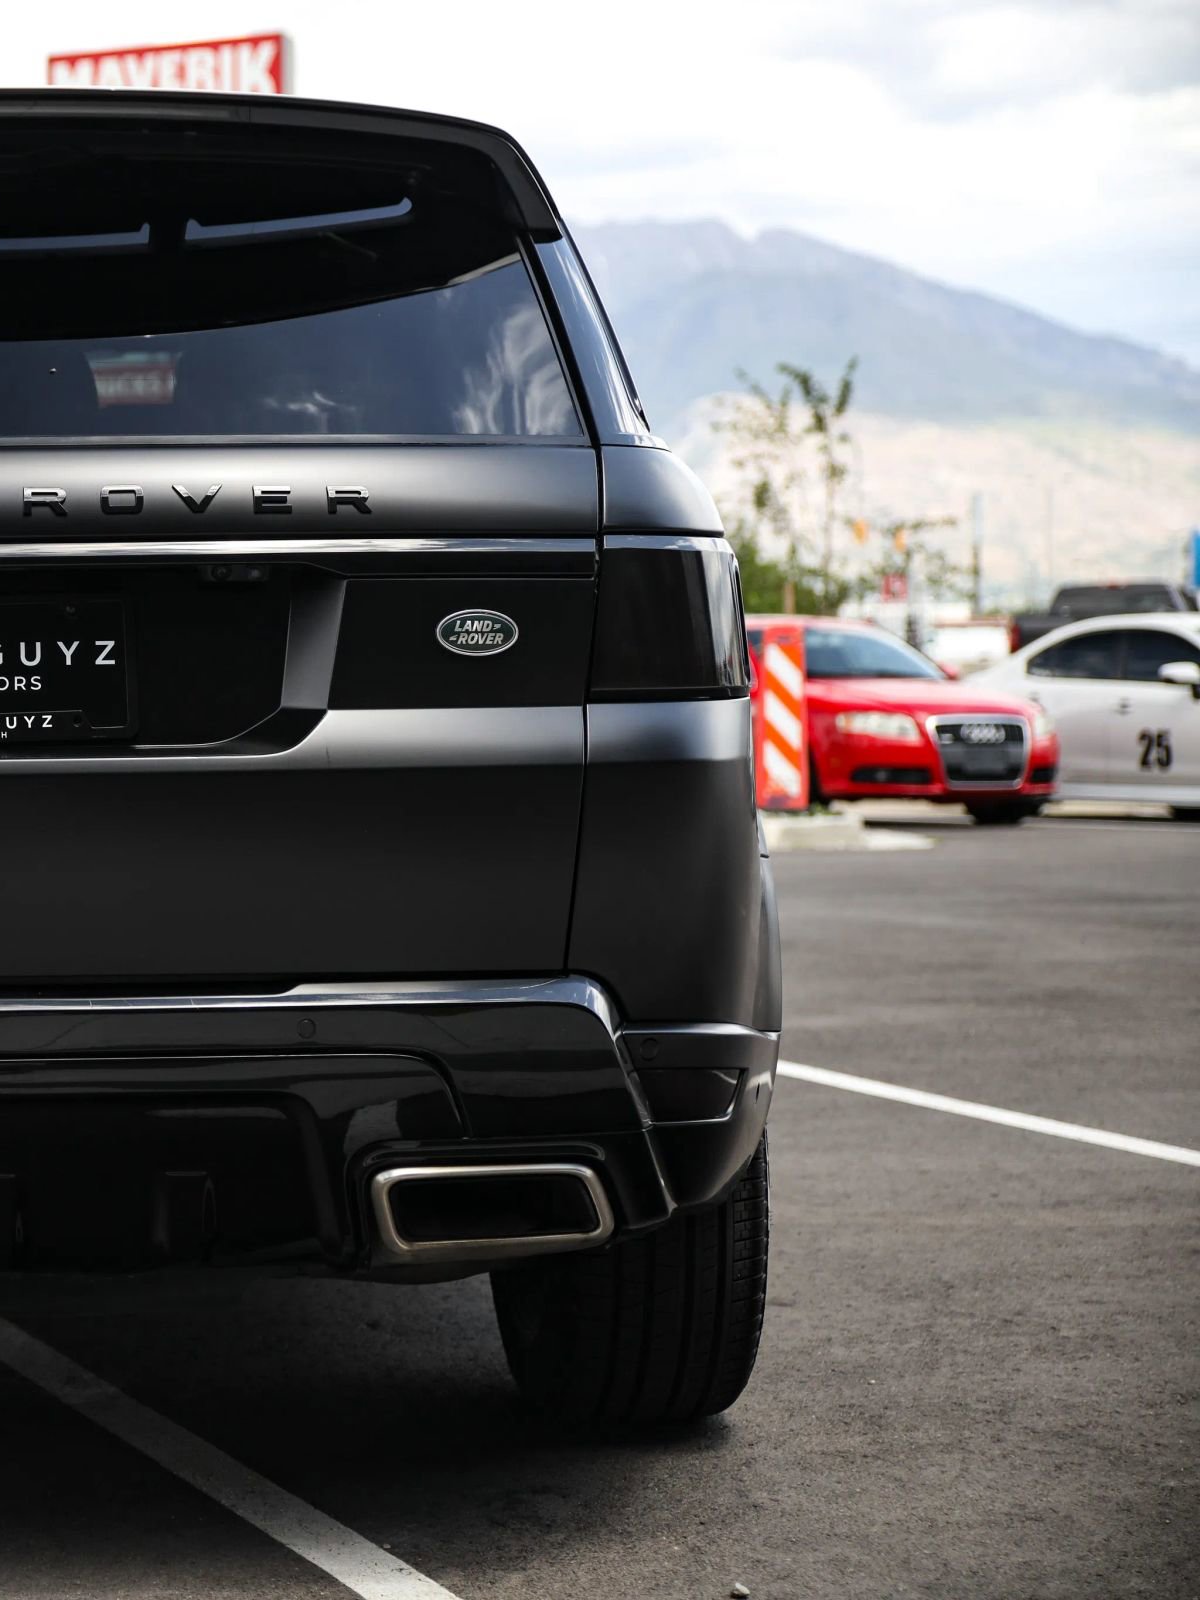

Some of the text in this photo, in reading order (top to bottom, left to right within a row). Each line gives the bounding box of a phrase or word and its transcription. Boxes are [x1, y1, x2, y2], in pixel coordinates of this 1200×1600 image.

[22, 483, 373, 517] ROVER
[454, 620, 492, 632] LAND
[456, 632, 504, 645] ROVER
[1138, 730, 1172, 770] 25
